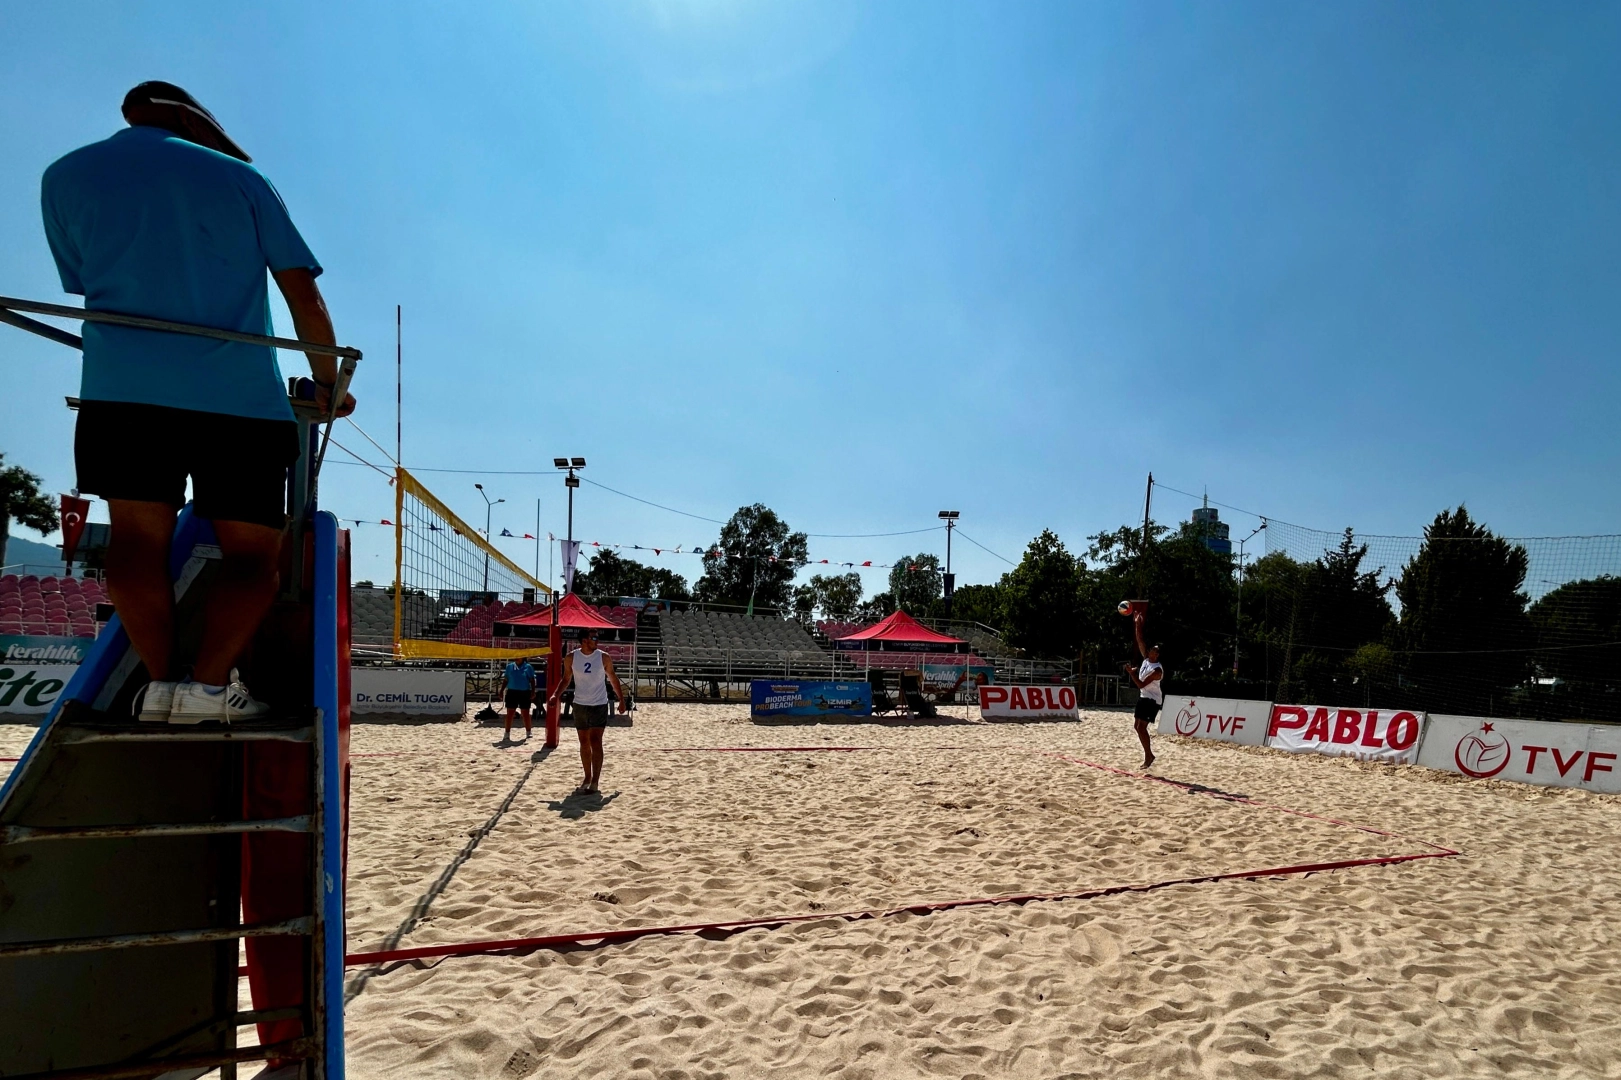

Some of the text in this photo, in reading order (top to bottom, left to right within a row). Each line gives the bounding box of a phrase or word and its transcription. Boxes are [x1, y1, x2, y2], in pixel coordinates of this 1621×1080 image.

[584, 662, 592, 673] 2
[356, 692, 453, 704] Dr. CEMİL TUGAY
[765, 694, 802, 704] BIODERMA
[979, 687, 1076, 710] PABLO
[1206, 714, 1246, 736] TVF
[1268, 705, 1419, 751] PABLO
[1522, 745, 1618, 782] TVF
